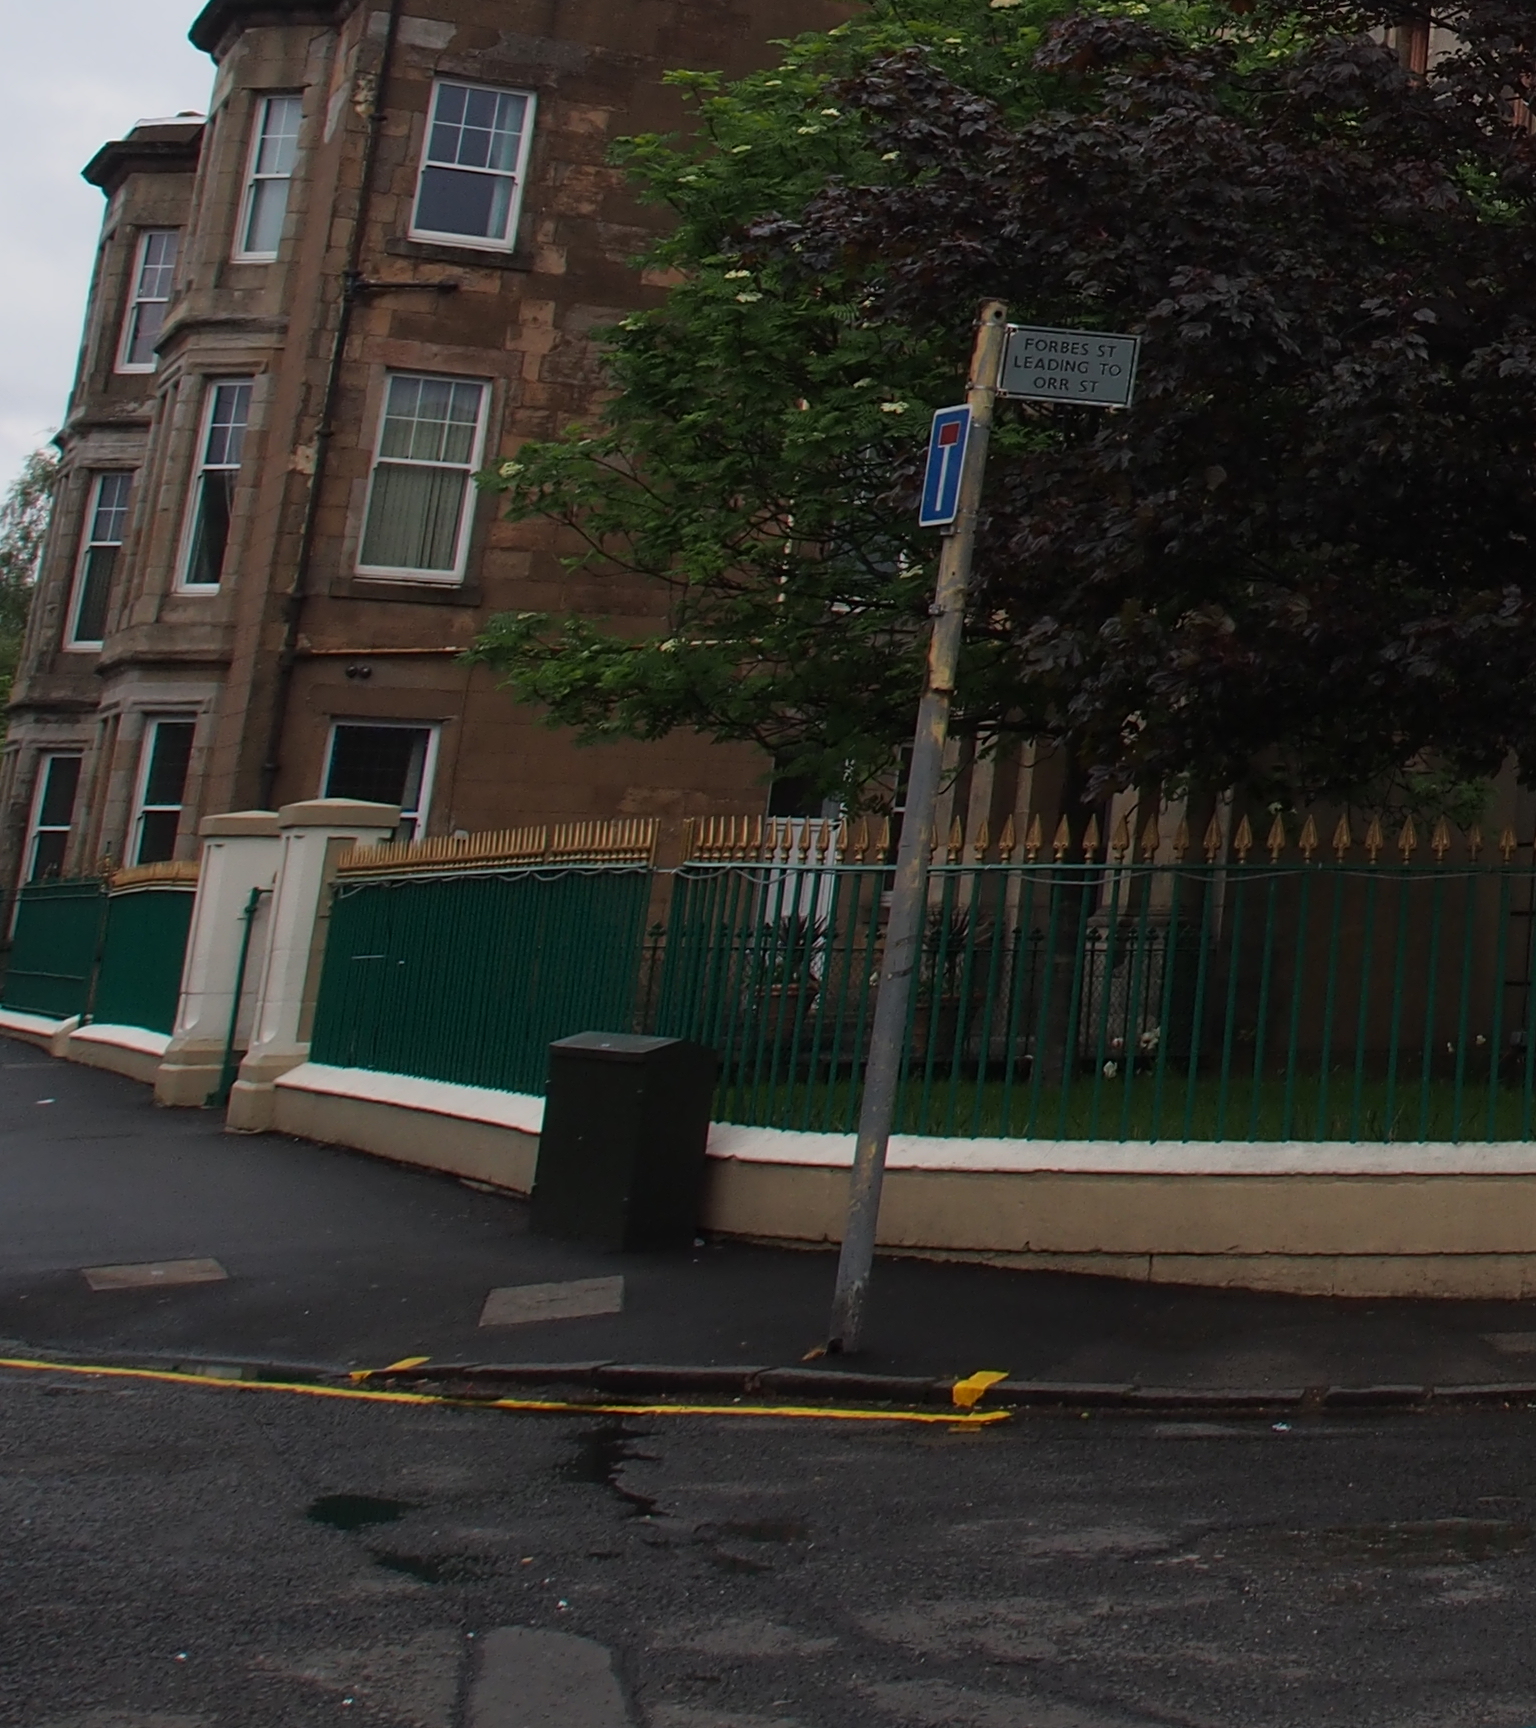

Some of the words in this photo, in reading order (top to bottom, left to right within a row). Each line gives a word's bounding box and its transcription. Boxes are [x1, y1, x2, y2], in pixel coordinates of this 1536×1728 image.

[1024, 338, 1089, 355] FORBES
[1097, 345, 1117, 358] ST
[1014, 355, 1089, 374] LEADING
[1099, 363, 1122, 376] TO
[1033, 377, 1069, 391] ORR
[1078, 380, 1099, 393] ST
